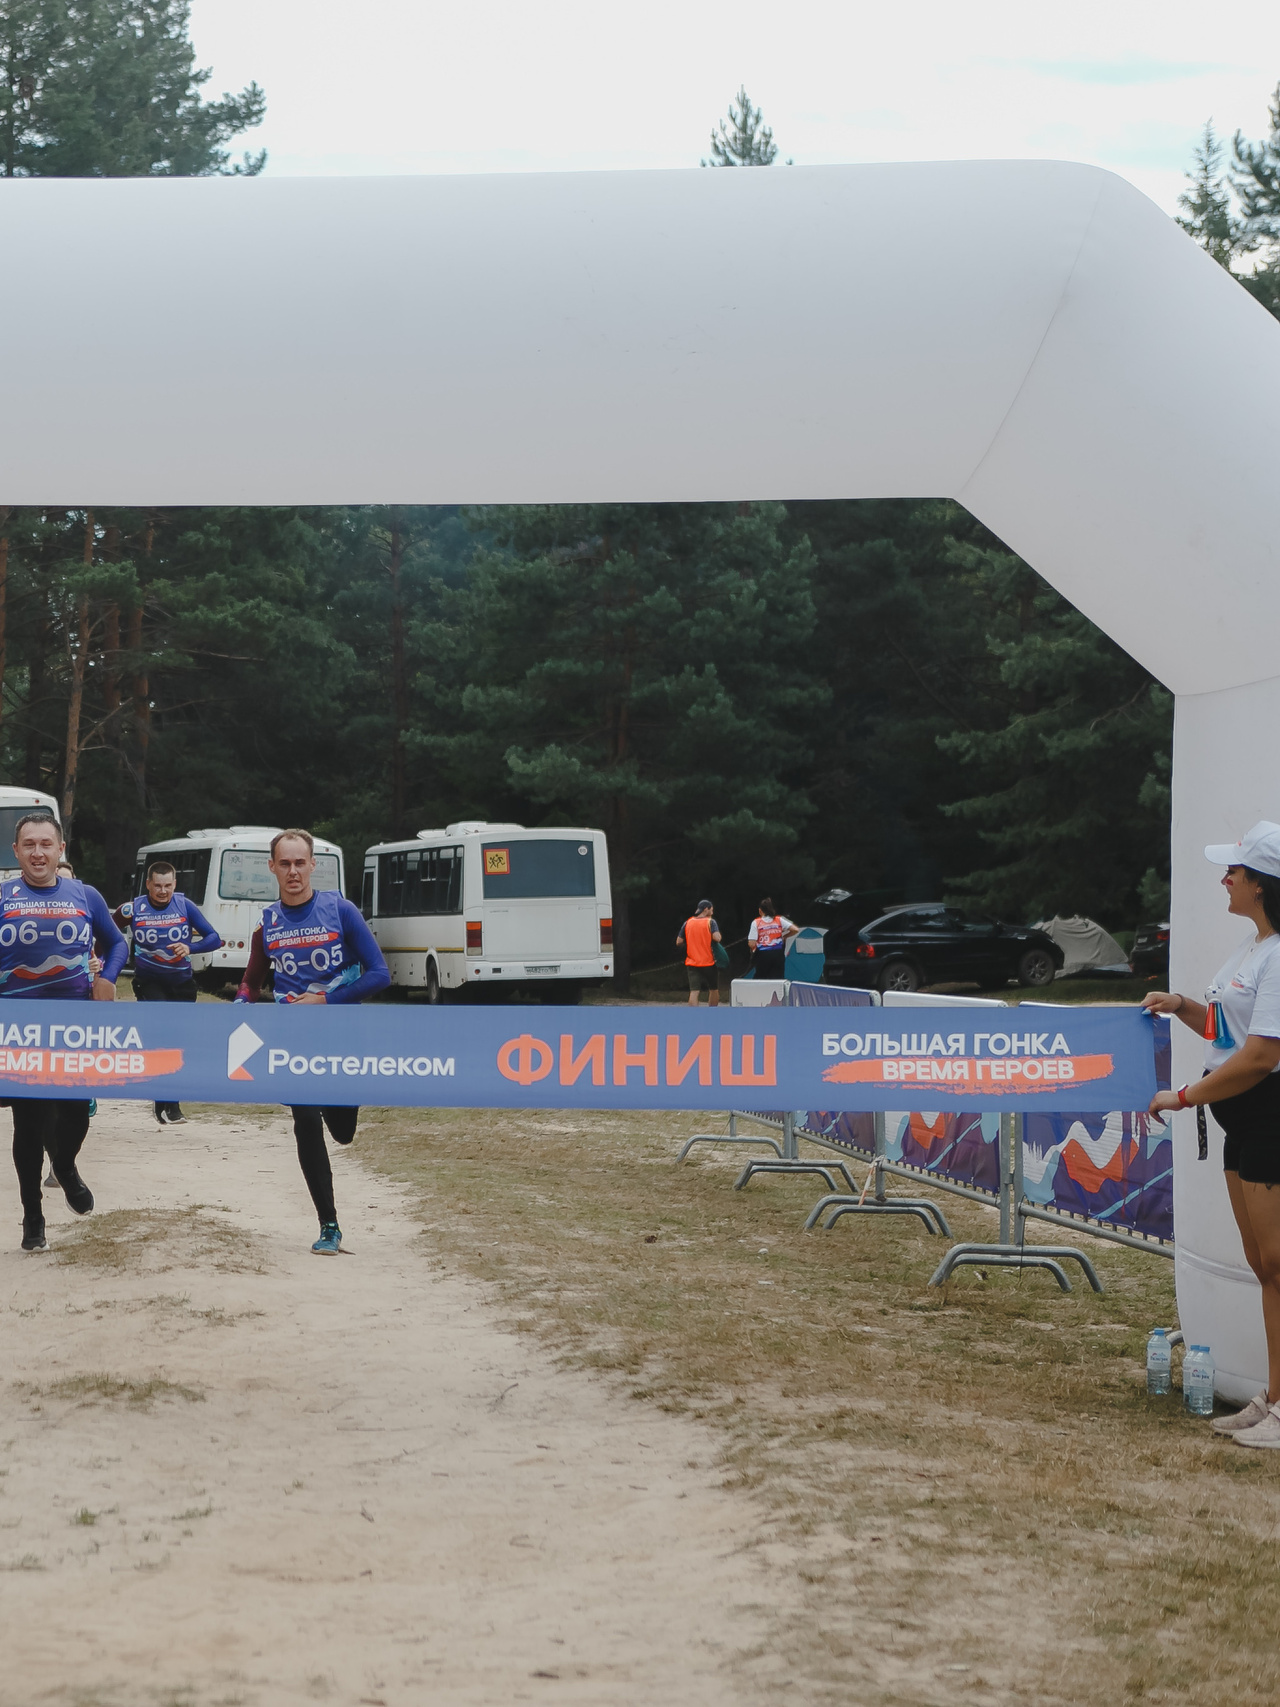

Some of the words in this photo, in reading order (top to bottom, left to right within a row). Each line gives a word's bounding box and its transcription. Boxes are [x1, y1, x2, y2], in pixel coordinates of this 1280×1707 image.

[3, 901, 45, 911] БОЛЬШАЯ
[20, 908, 47, 916] ВРЕМЯ
[48, 907, 77, 915] ГЕРОЕВ
[134, 925, 189, 944] 06-03
[266, 929, 300, 942] БОЛЬШАЯ
[300, 926, 328, 936] ГОНКА
[278, 937, 301, 947] ВРЕМЯ
[301, 934, 329, 943] ГЕРОЕВ
[49, 1025, 143, 1049] ГОНКА
[821, 1033, 966, 1056] БОЛЬШАЯ
[973, 1033, 1071, 1055] ГОНКА
[50, 1053, 145, 1074] ГЕРОЕВ
[268, 1049, 455, 1077] Ростелеком
[496, 1034, 777, 1086] ФИНИШ
[881, 1060, 969, 1081] ВРЕМЯ
[976, 1060, 1075, 1080] ГЕРОЕВ
